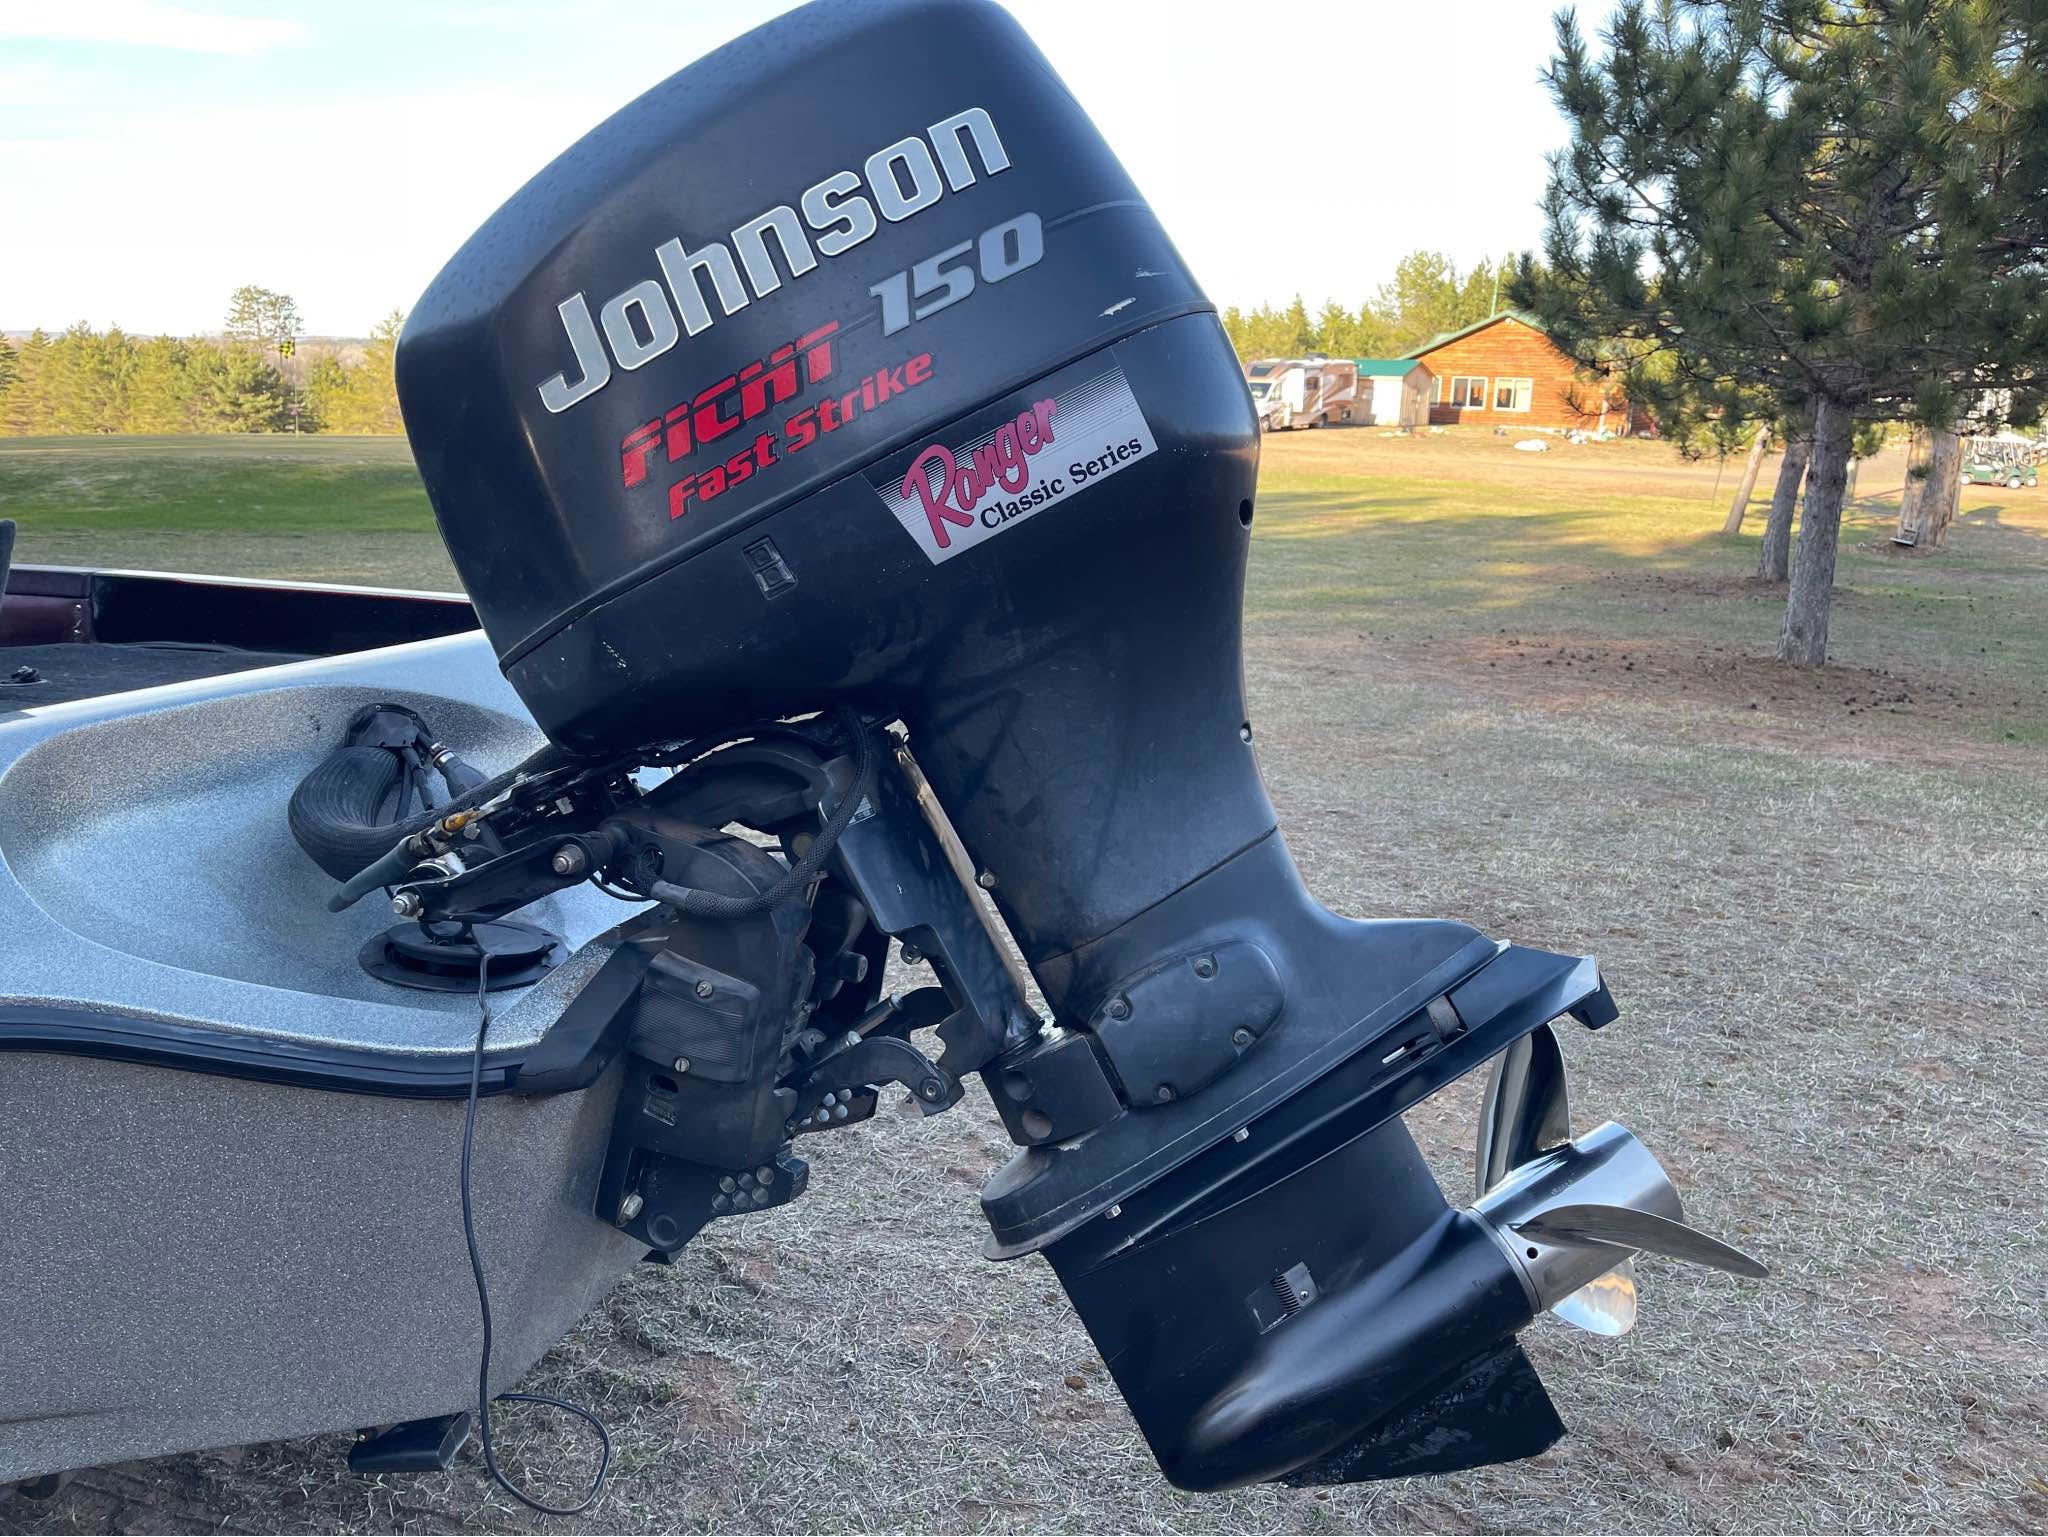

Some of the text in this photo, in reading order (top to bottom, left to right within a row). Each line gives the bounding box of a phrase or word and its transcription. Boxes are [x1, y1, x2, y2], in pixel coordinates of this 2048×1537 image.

[537, 107, 1012, 413] Johnson
[869, 211, 1044, 337] 150
[668, 351, 935, 522] Fast Strike
[900, 398, 1058, 548] Ranger
[979, 437, 1143, 529] Classic Series
